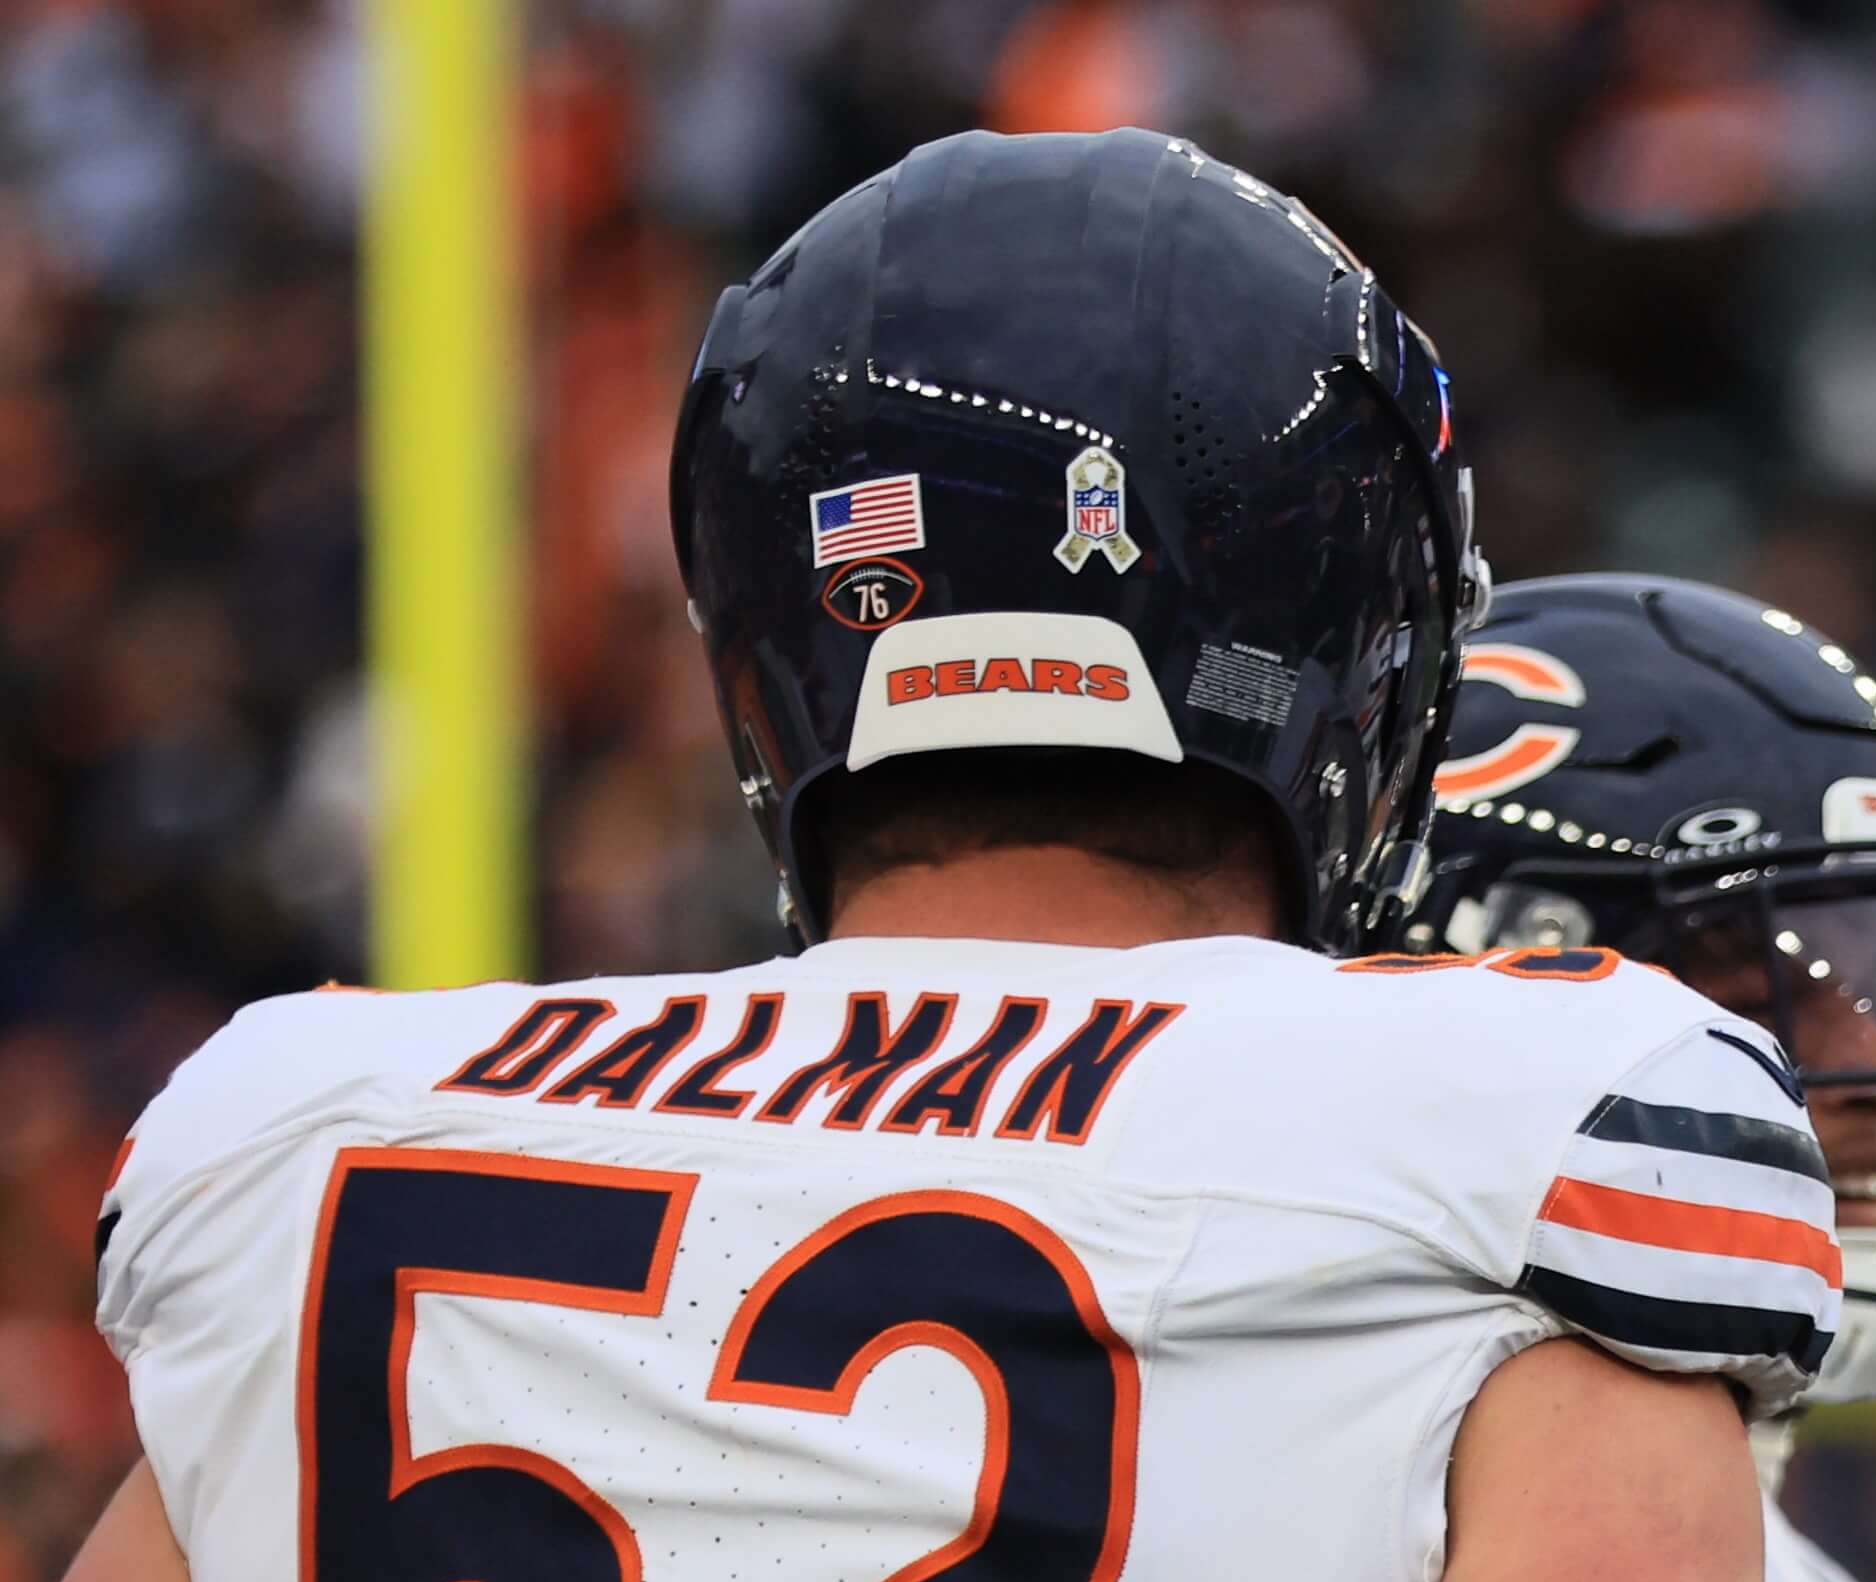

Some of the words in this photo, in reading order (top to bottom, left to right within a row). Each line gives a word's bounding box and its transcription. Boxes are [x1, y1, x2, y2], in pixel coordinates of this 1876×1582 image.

[1077, 508, 1116, 535] NFL
[853, 582, 890, 623] 76
[886, 657, 1131, 706] BEARS
[433, 992, 1187, 1145] DALMAN
